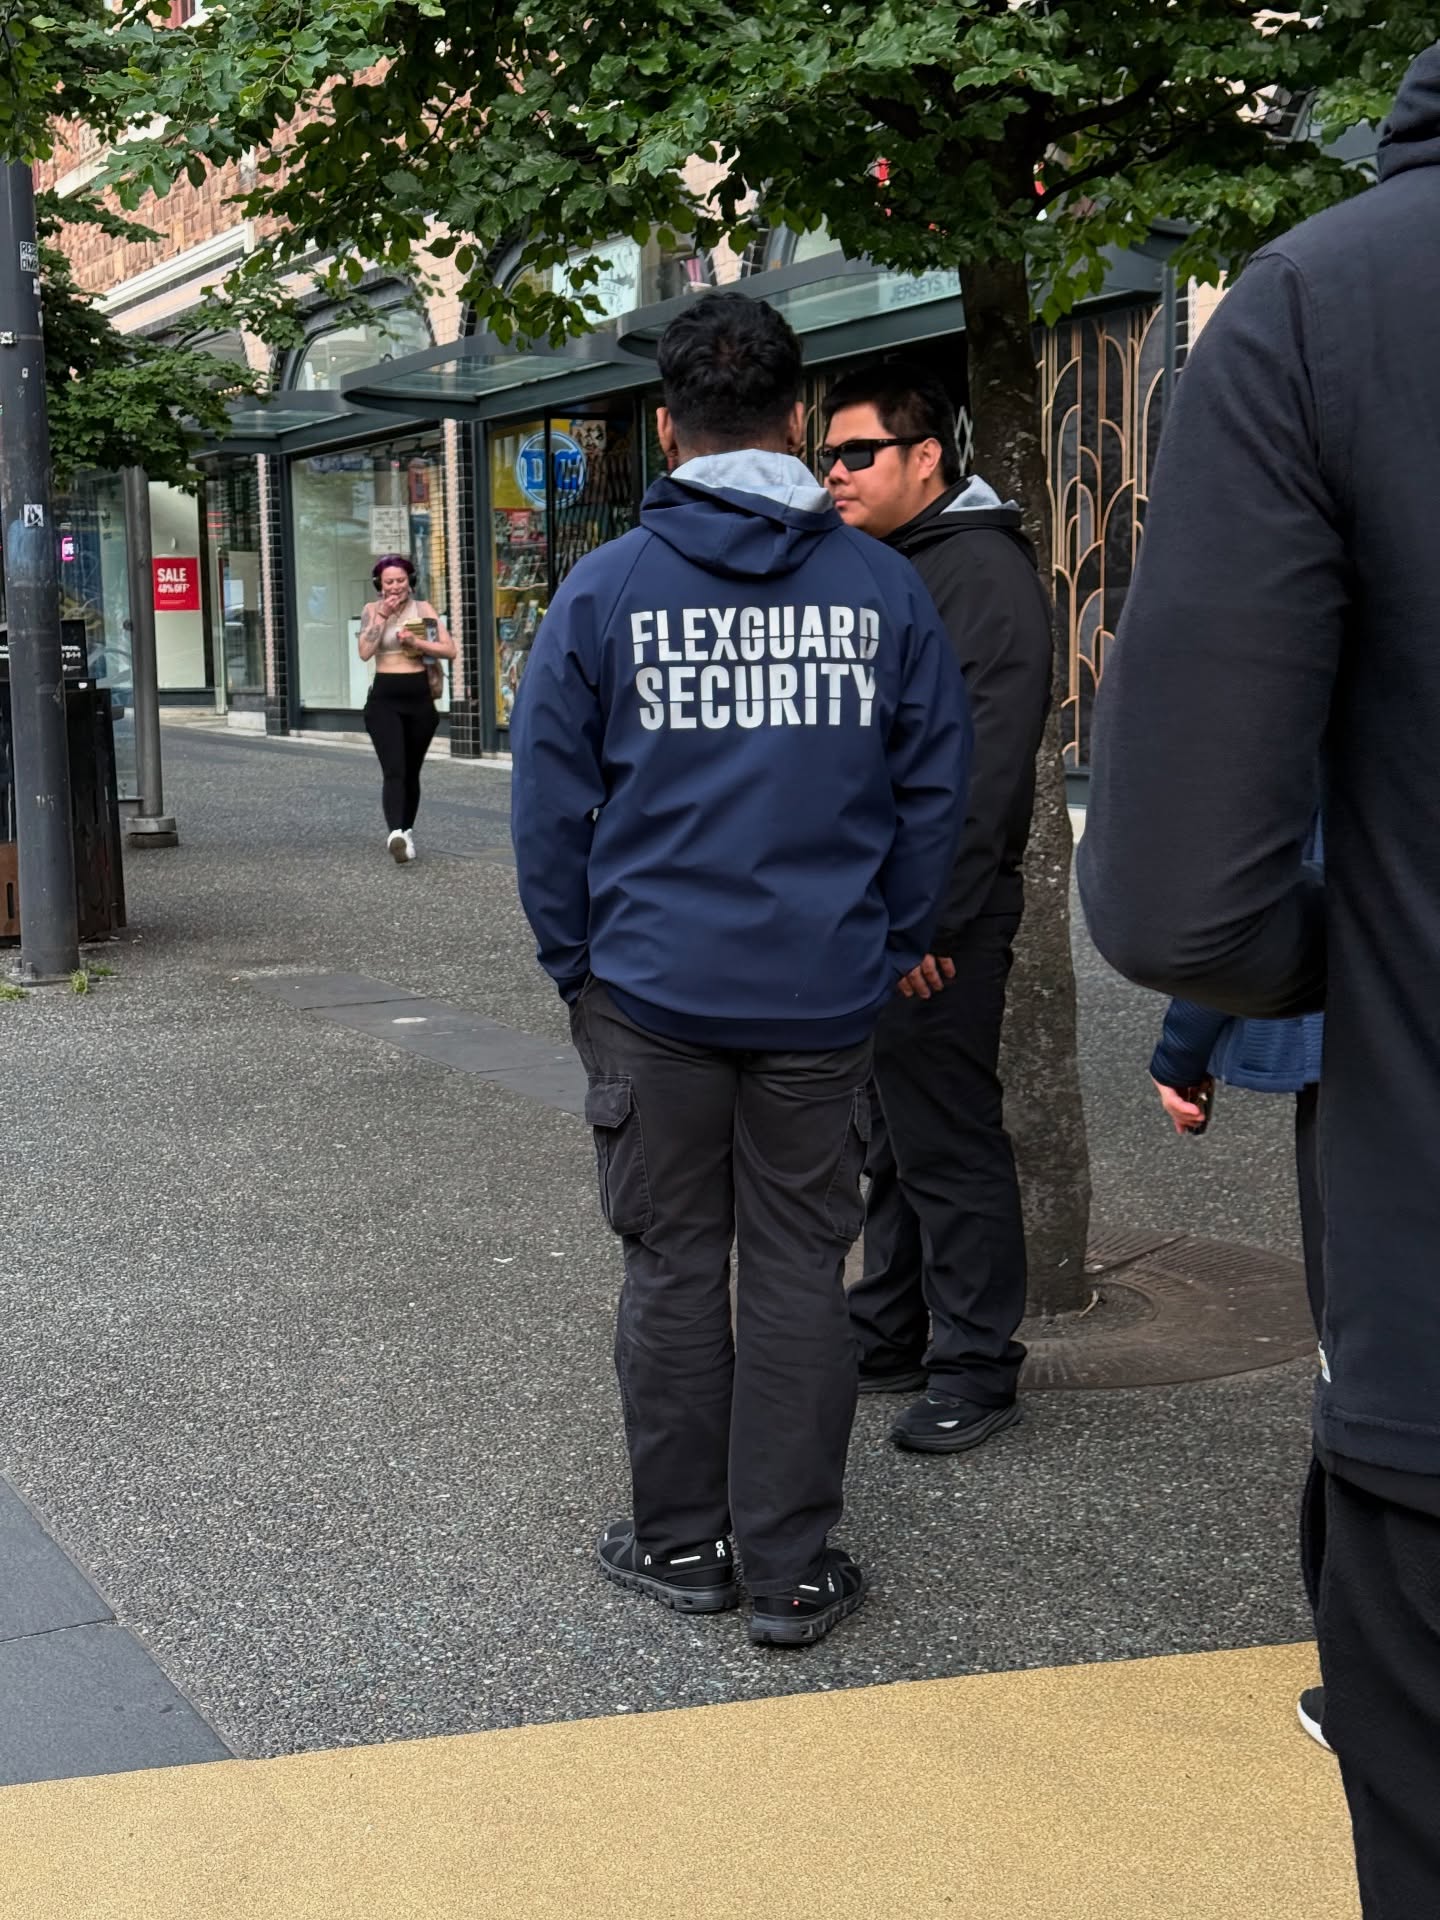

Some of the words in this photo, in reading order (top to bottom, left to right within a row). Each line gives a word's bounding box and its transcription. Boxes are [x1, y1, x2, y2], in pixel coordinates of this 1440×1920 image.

[157, 567, 187, 583] SALE
[630, 605, 880, 664] FLEXGUARD
[635, 663, 876, 731] SECURITY
